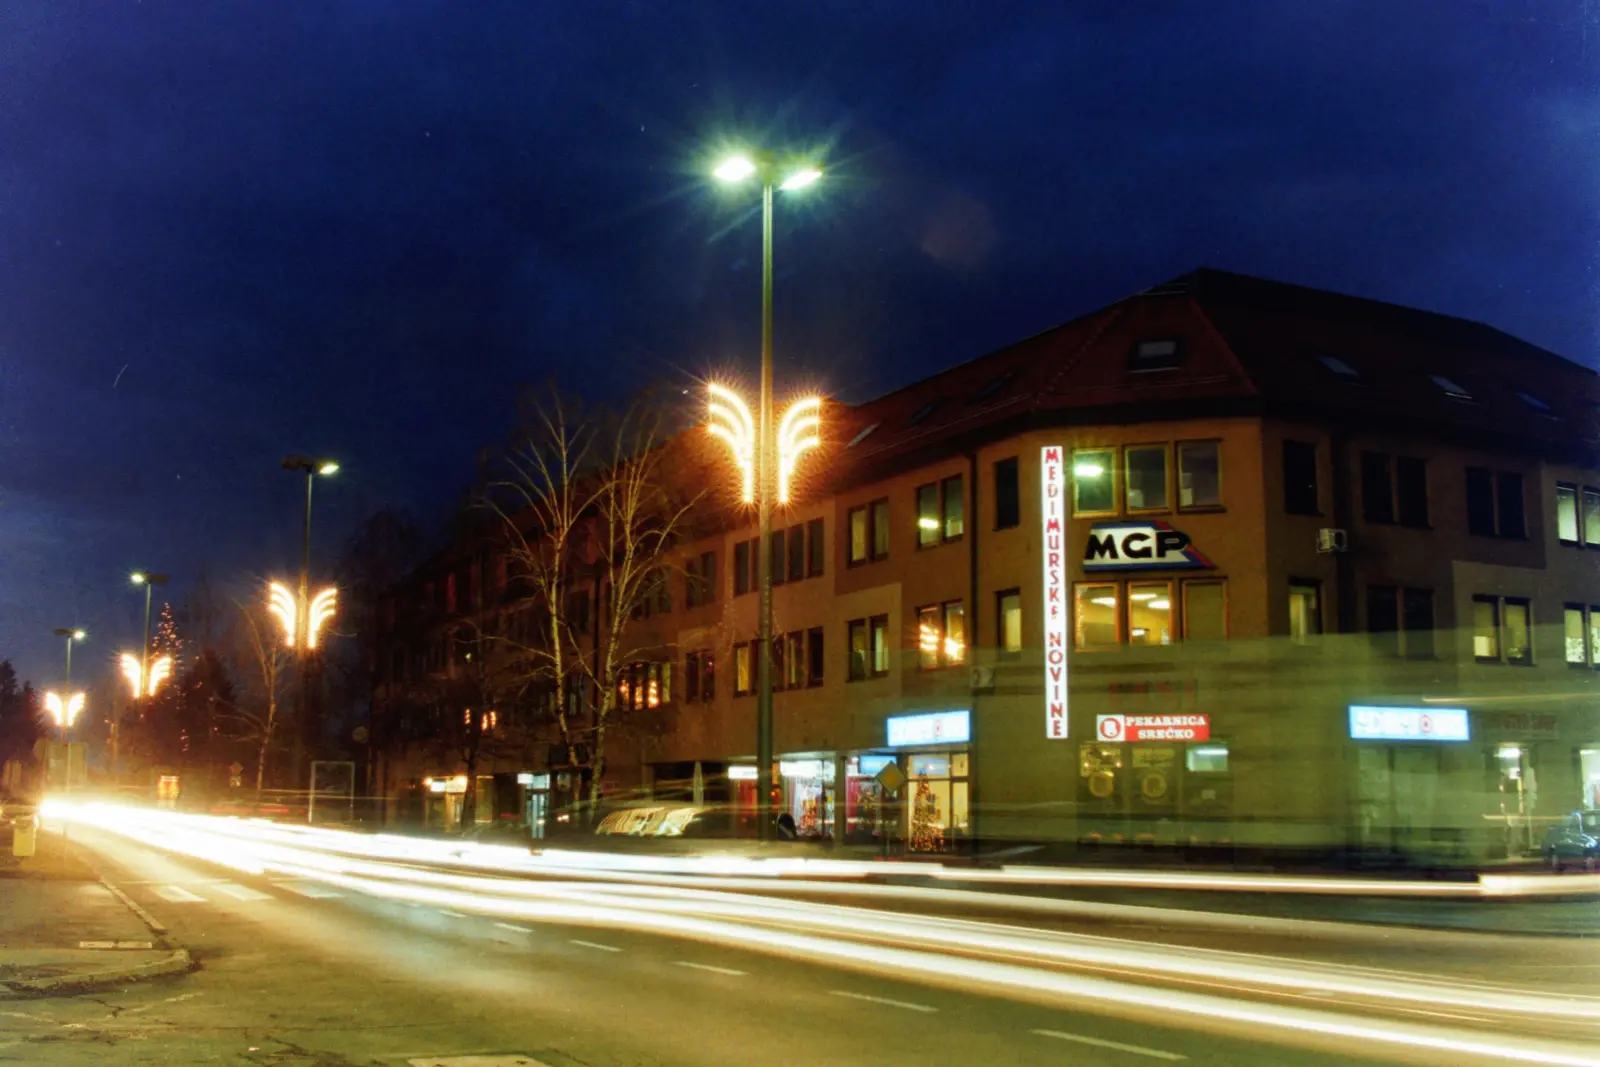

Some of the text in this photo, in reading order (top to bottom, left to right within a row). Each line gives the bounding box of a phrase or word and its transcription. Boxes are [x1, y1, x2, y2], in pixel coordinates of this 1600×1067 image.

[1084, 531, 1191, 559] MGP
[1048, 632, 1064, 737] NOVINE
[1126, 715, 1206, 726] PEKARNICA
